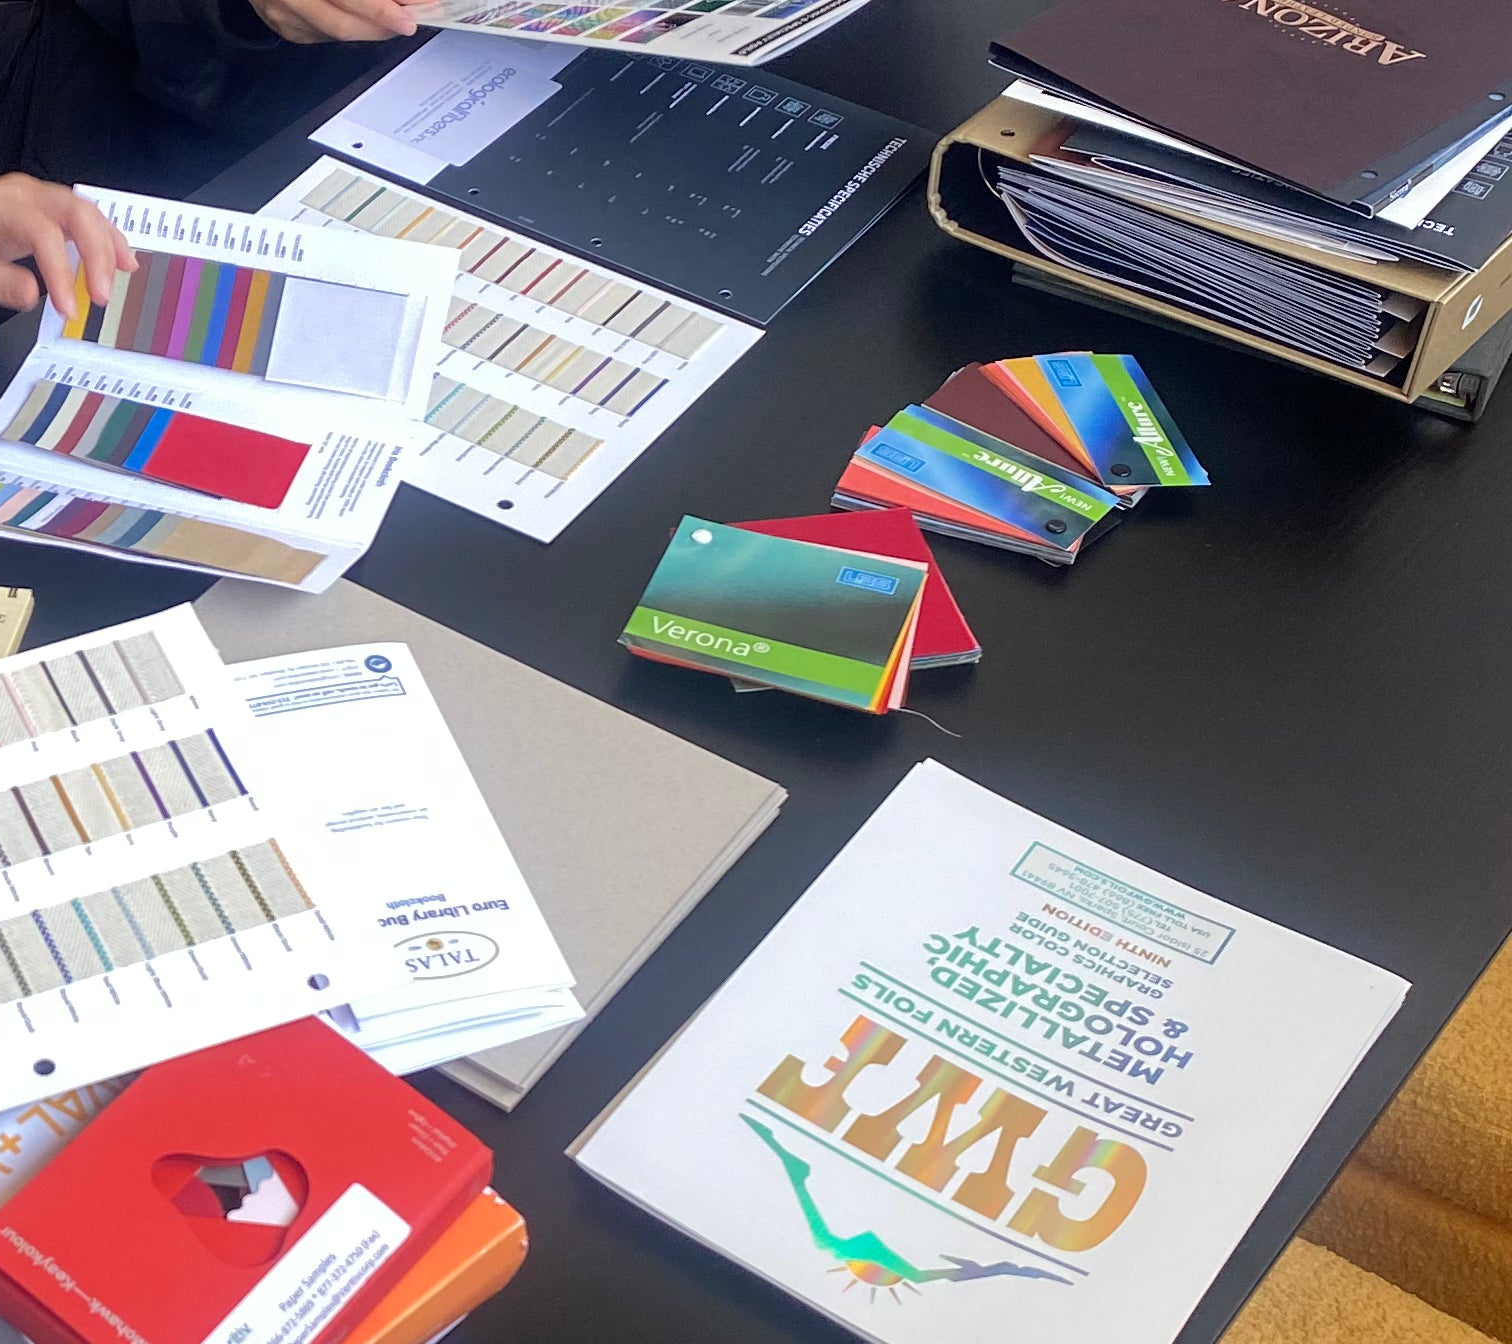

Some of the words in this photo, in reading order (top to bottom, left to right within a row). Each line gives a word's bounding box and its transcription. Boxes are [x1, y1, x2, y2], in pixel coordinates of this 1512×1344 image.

[853, 136, 908, 184] TECHNISCHE
[798, 181, 860, 236] SPECIFICATIES
[1159, 455, 1175, 477] NEW!
[1058, 490, 1092, 513] NEW!
[841, 569, 896, 592] LBS
[472, 900, 510, 911] Euro
[1058, 887, 1076, 900] NV
[413, 905, 470, 921] Library
[1016, 911, 1071, 942] GUIDE
[1041, 903, 1115, 942] EDITION
[1008, 922, 1072, 956] COLOR
[1116, 939, 1172, 968] NINTH
[1158, 932, 1192, 951] Isidor
[405, 949, 480, 973] TALAS
[955, 925, 1156, 1027] SPECIALTY
[1073, 938, 1174, 989] SELECTION
[1080, 953, 1164, 999] GRAPHICS
[850, 972, 934, 1026] FOILS
[922, 934, 1194, 1070] HOLOGRAPHIC
[926, 956, 1165, 1086] METALLIZED,
[1163, 1018, 1189, 1039] &
[934, 1017, 1076, 1097] WESTERN
[756, 1014, 1150, 1253] GWF
[1081, 1091, 1185, 1140] GREAT
[360, 1229, 381, 1251] (Fax)
[278, 1286, 305, 1312] Paper
[301, 1252, 338, 1289] Samples
